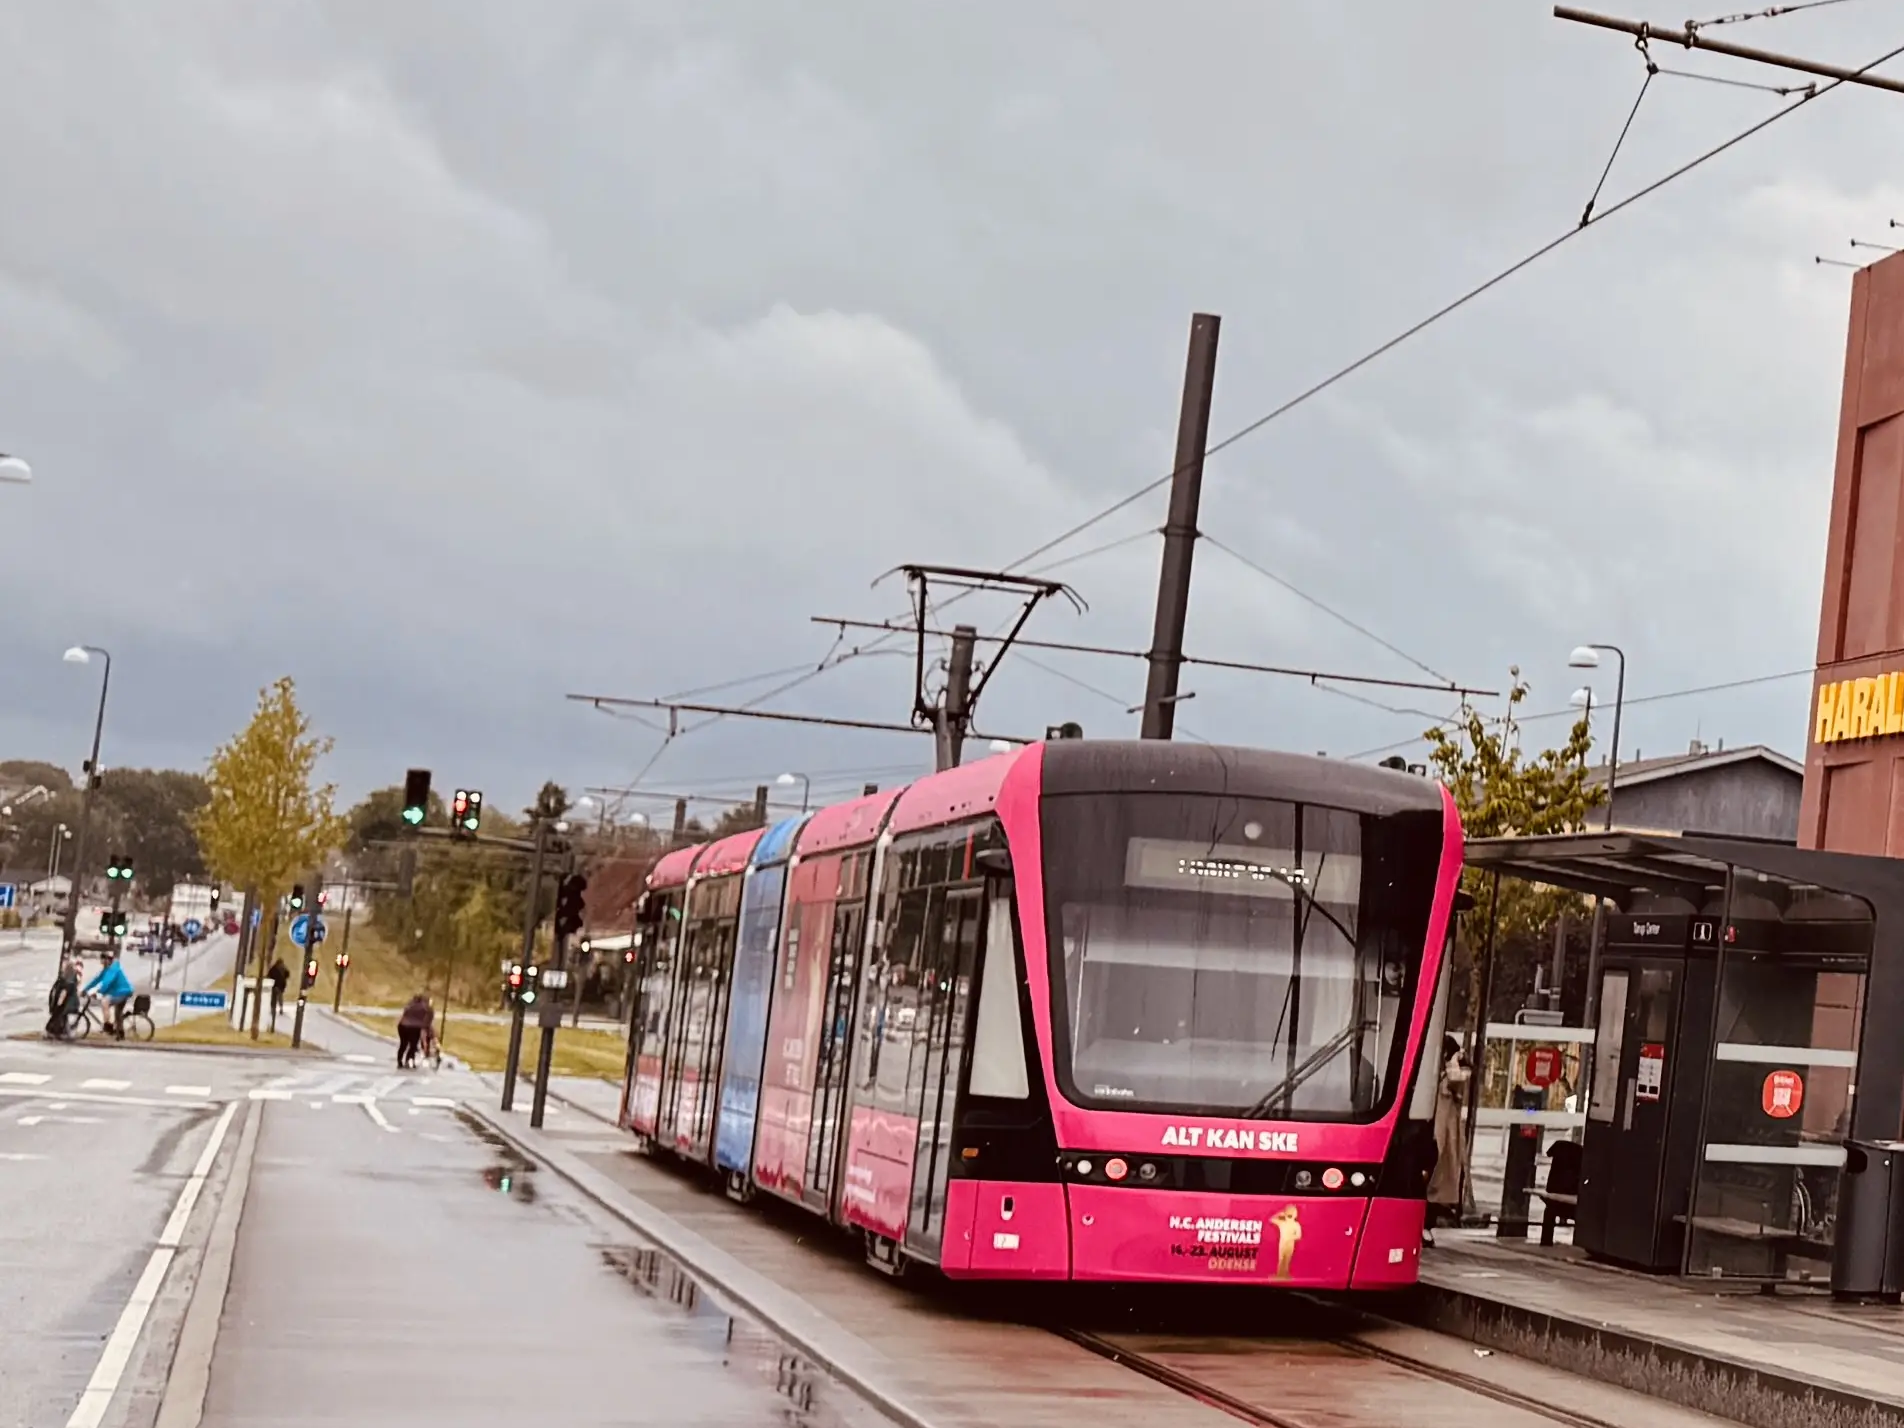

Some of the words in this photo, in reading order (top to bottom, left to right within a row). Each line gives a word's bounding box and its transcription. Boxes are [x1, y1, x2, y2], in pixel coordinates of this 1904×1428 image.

[1161, 1126, 1204, 1146] ALT
[1206, 1128, 1255, 1150] KAN
[1258, 1131, 1298, 1153] SKE
[1197, 1230, 1262, 1244] FESTIVALS
